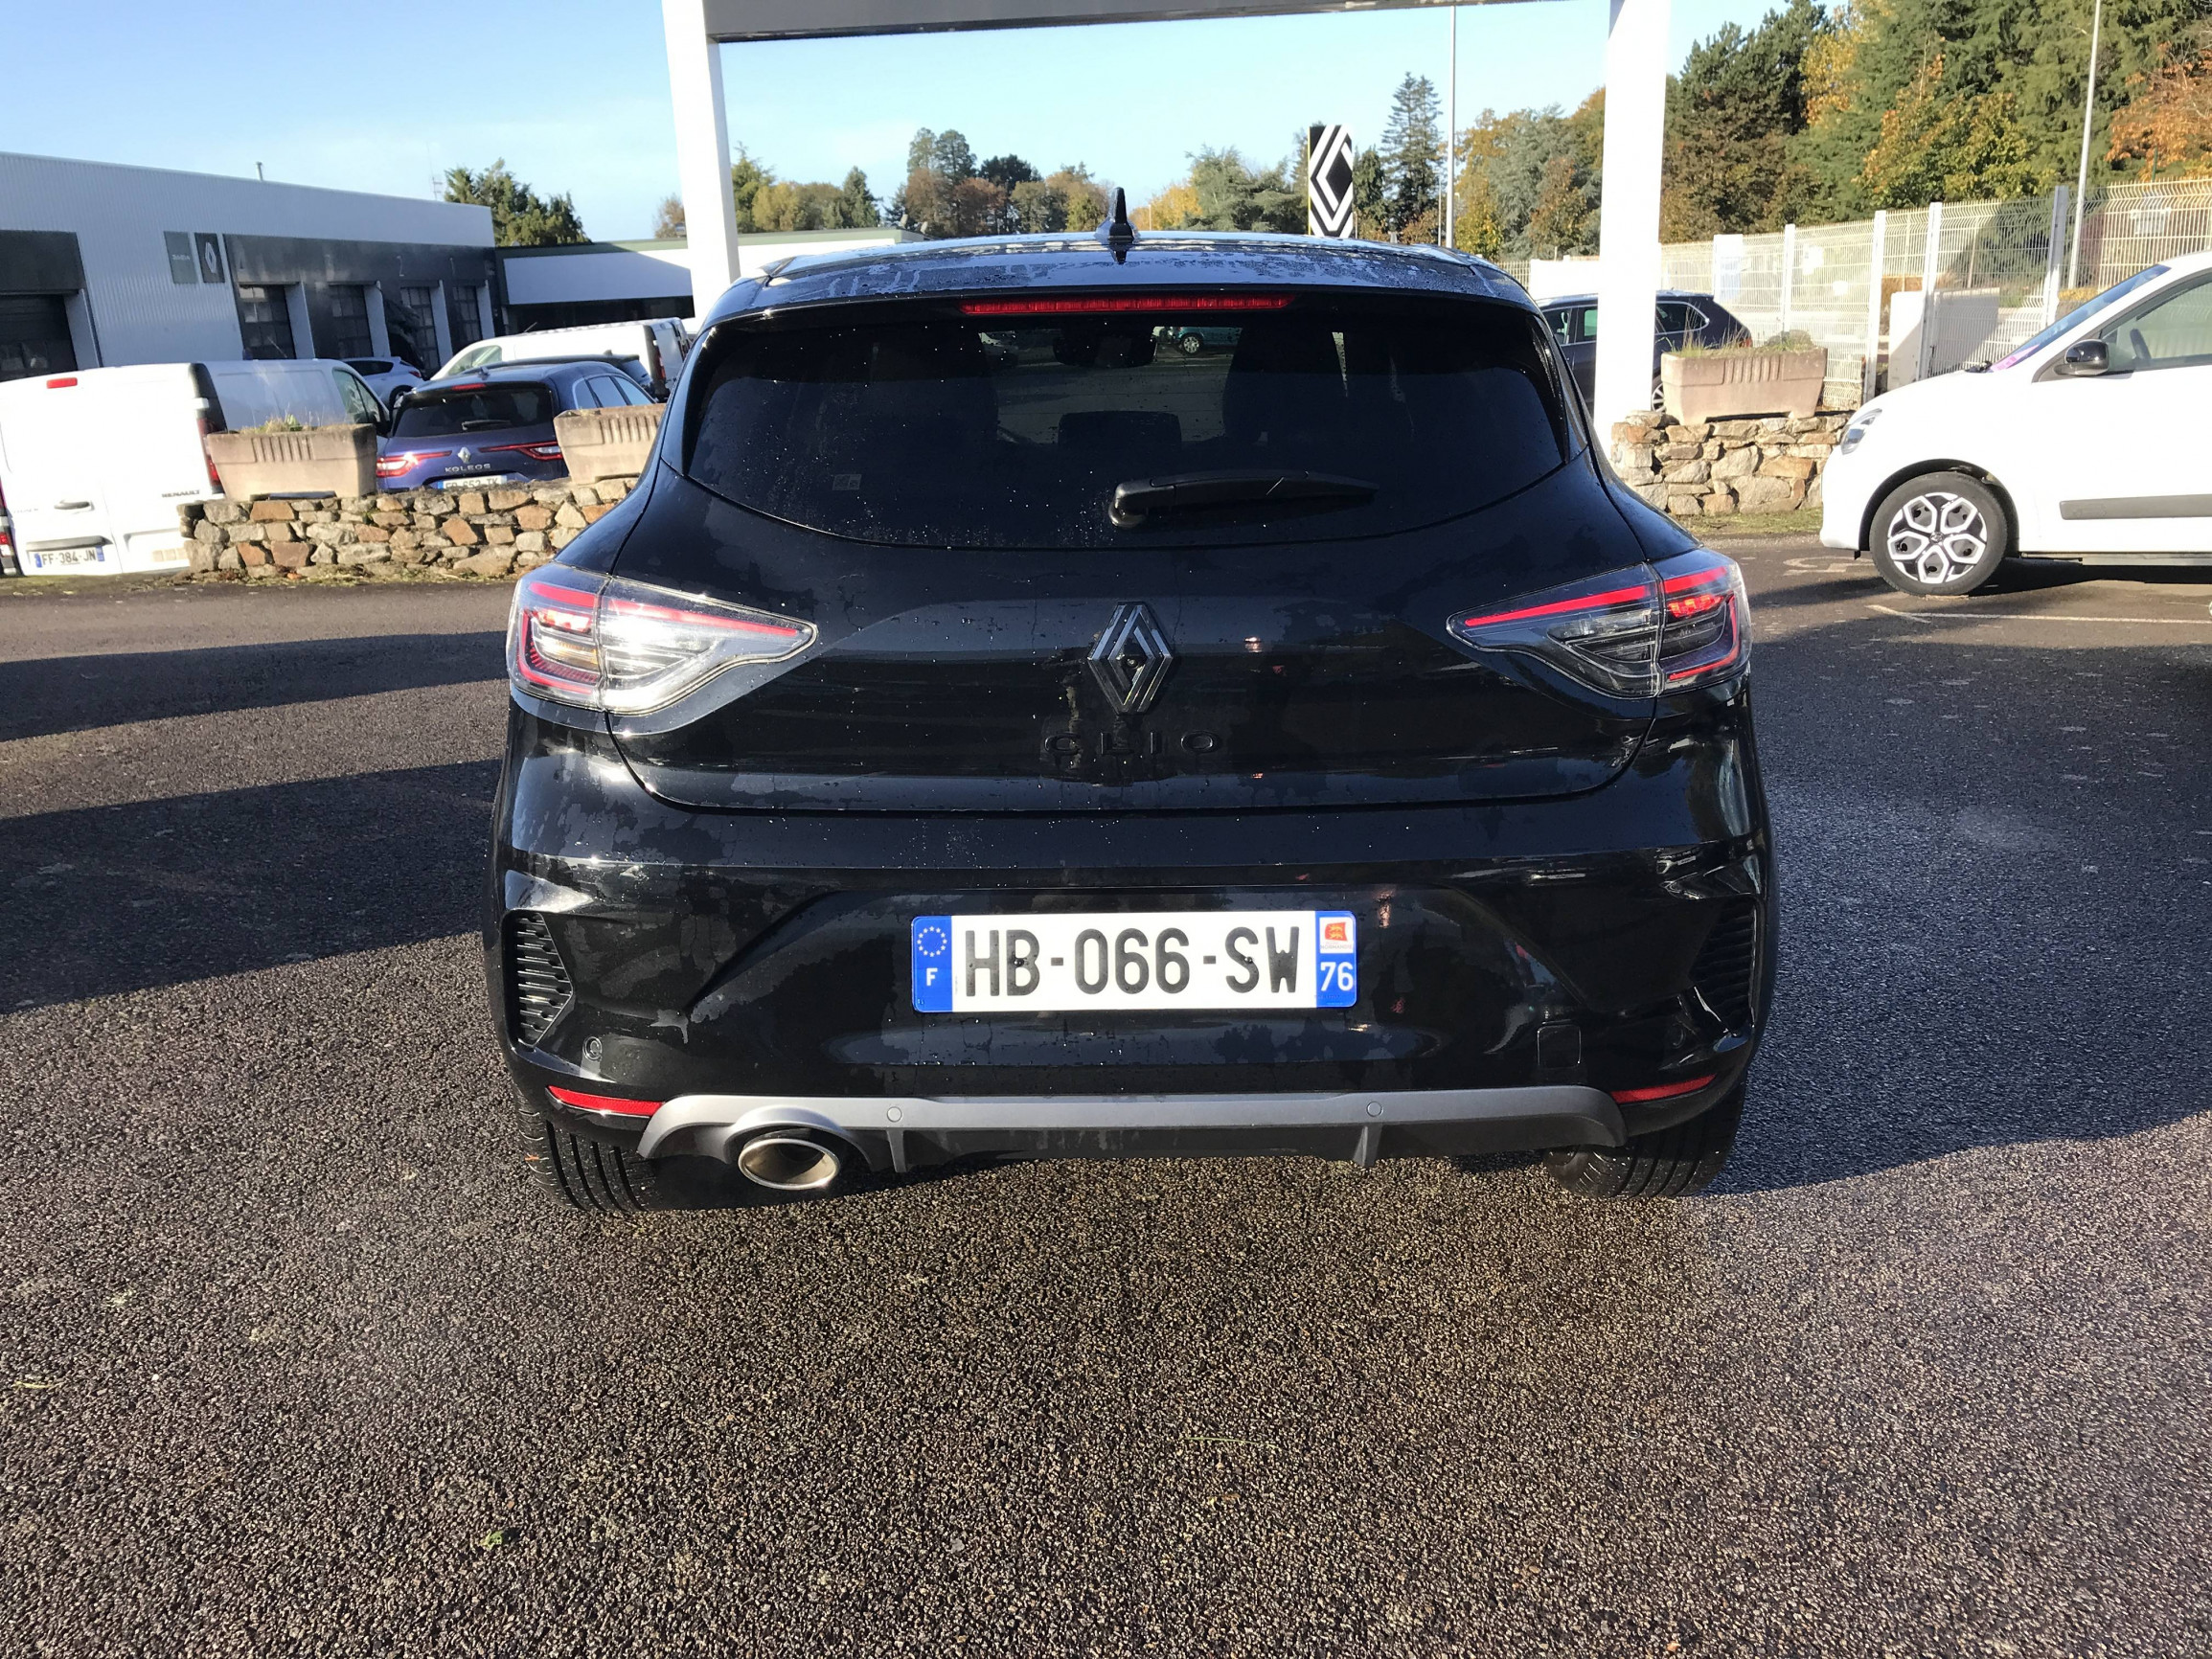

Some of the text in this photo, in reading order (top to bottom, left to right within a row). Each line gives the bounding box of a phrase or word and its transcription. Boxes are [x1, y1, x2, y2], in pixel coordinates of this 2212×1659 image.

[445, 464, 490, 472] KOLEOS
[161, 489, 200, 498] RENAULT
[41, 549, 97, 566] FF-384-JN
[1044, 731, 1219, 756] CLIO
[965, 926, 1300, 997] HB-066-SW
[925, 967, 939, 987] F
[1320, 961, 1354, 991] 76
